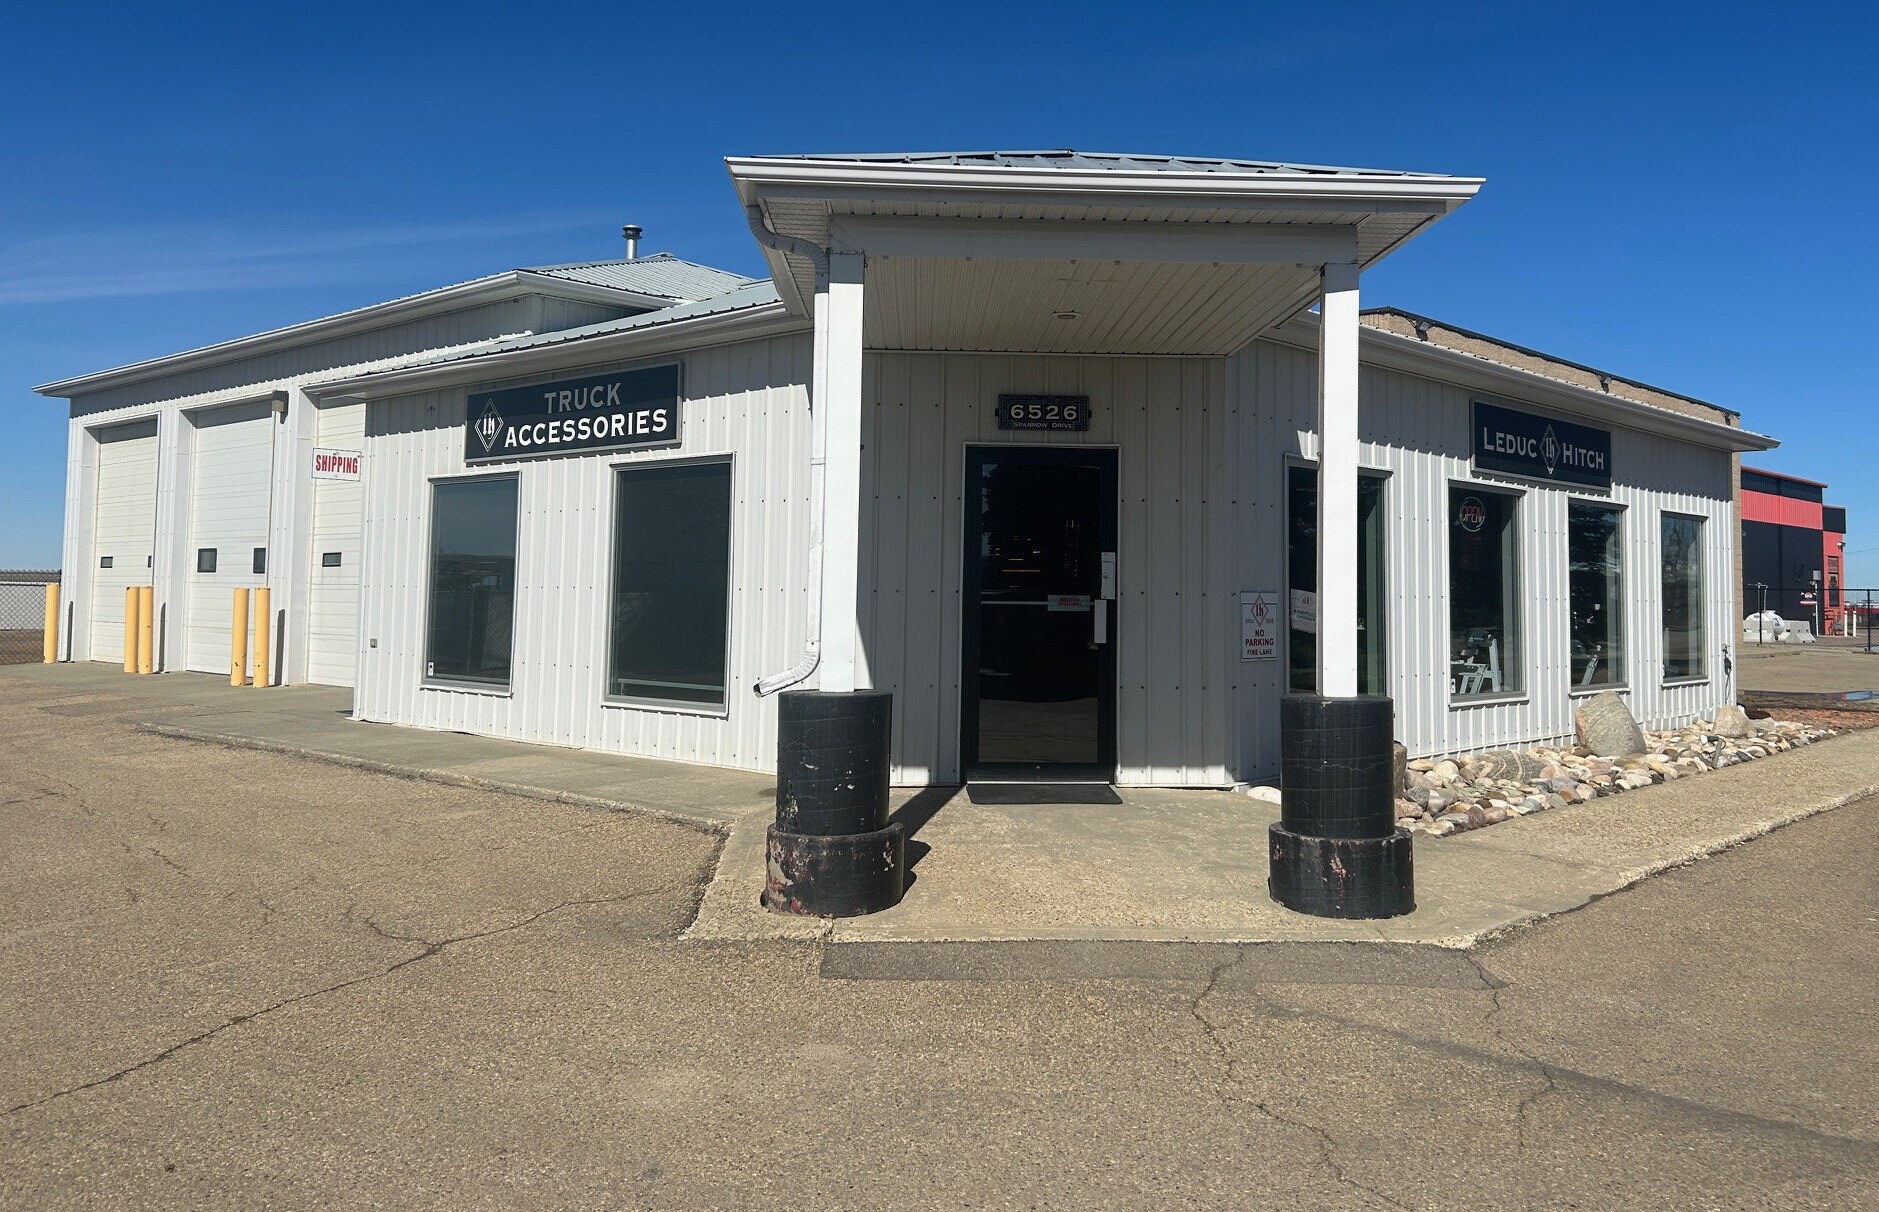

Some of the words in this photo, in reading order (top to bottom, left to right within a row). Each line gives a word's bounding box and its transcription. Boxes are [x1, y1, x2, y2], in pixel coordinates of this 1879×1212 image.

[544, 383, 622, 414] TRUCK
[1010, 404, 1077, 420] 6526
[504, 408, 668, 448] ACCESSORIES
[1483, 427, 1538, 458] LEDUC
[1563, 443, 1605, 470] HITCH
[315, 454, 358, 474] SHIPPING
[1461, 505, 1483, 523] OPEN
[1245, 638, 1274, 647] PARKING
[1255, 629, 1264, 637] NO
